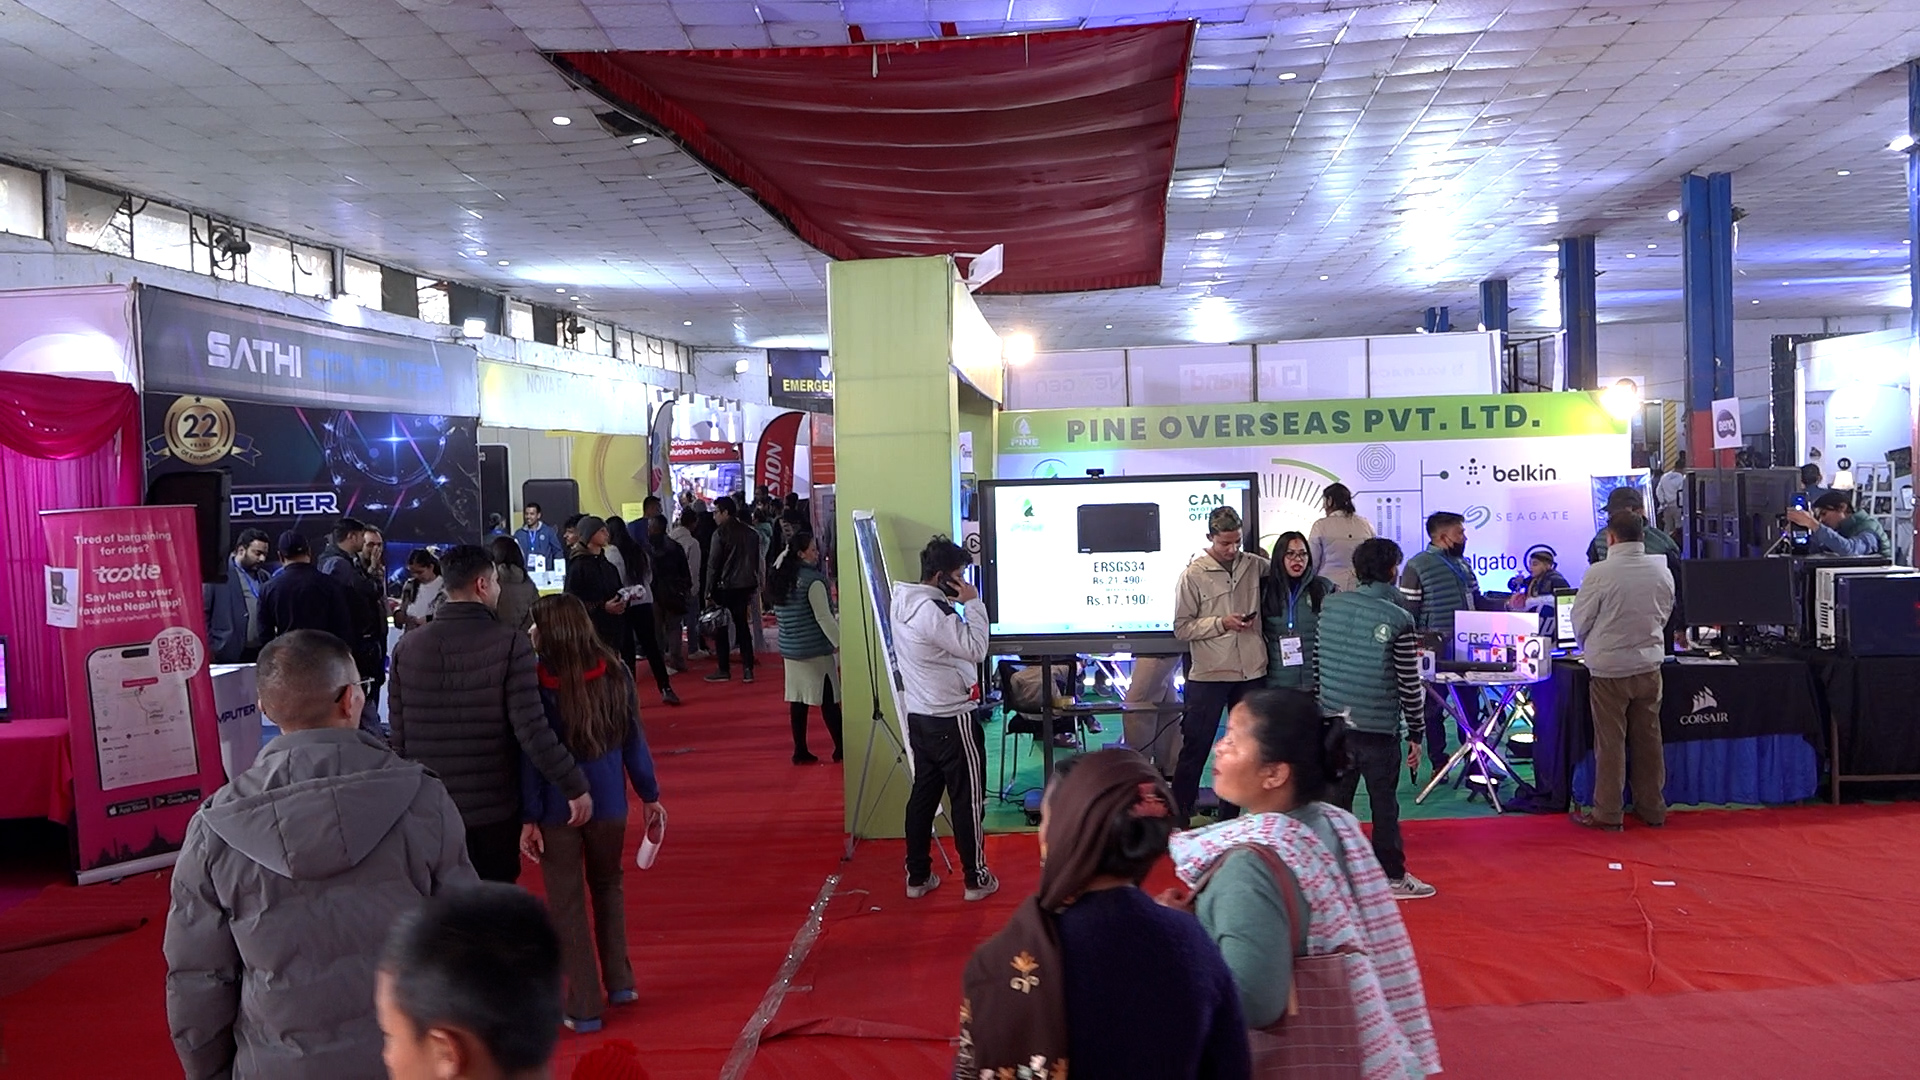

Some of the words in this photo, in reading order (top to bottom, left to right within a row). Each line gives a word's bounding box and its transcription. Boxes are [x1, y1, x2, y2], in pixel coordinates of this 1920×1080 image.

[207, 331, 302, 378] SATHI
[183, 413, 218, 438] 22
[1067, 417, 1147, 443] PINE
[1159, 410, 1350, 440] OVERSEAS
[1364, 408, 1447, 433] PVT.
[1461, 405, 1541, 430] LTD.
[1010, 438, 1039, 447] PINE
[694, 446, 726, 455] Provider
[1492, 463, 1557, 482] belkin
[230, 491, 340, 516] PUTER
[1188, 493, 1225, 506] CAN
[1496, 510, 1569, 522] SEAGATE
[74, 534, 102, 545] Tired
[104, 534, 115, 544] of
[100, 546, 116, 556] for
[118, 543, 150, 555] rides?
[92, 562, 161, 584] tootle
[85, 593, 107, 605] Say
[108, 589, 135, 601] hello
[136, 589, 148, 598] to
[149, 588, 173, 599] your
[79, 603, 123, 617] favorite
[1679, 712, 1729, 725] CORSAIR
